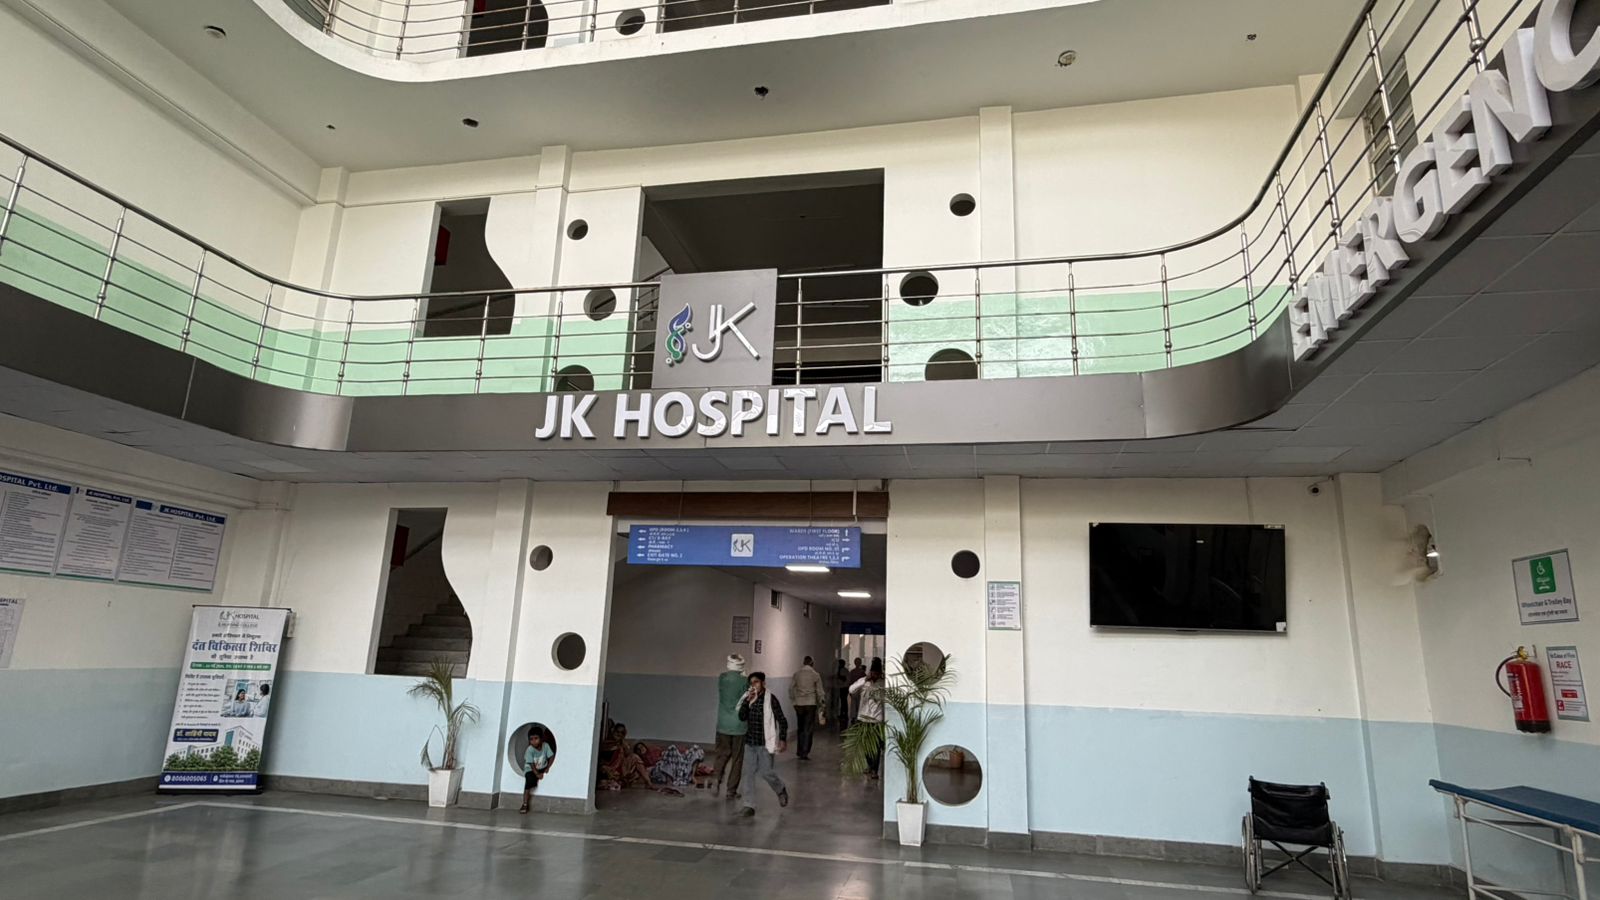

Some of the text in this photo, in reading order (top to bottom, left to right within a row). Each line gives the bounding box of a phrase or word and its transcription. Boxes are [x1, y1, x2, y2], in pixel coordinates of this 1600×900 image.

[691, 302, 761, 362] JK
[535, 385, 892, 441] JK HOSPITAL
[192, 640, 278, 652] दंत चिकित्सा शिविर
[1556, 660, 1572, 669] RACE
